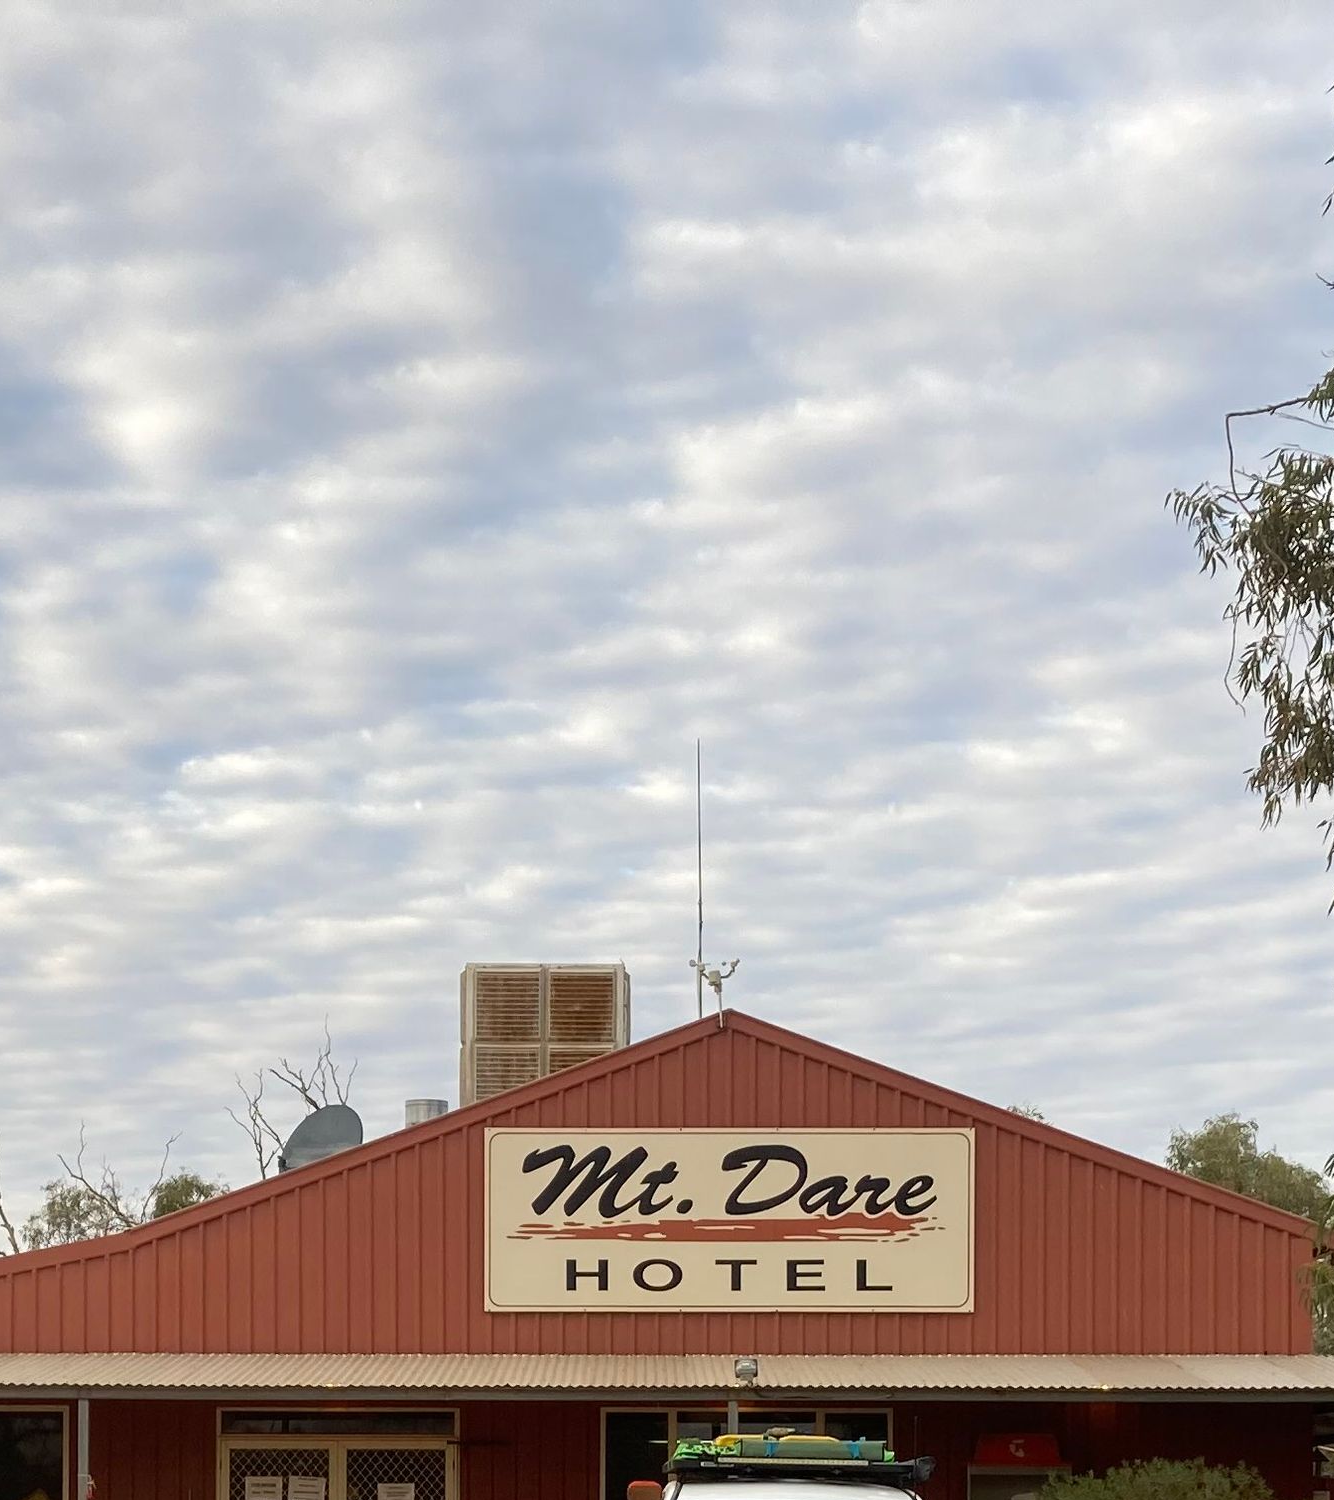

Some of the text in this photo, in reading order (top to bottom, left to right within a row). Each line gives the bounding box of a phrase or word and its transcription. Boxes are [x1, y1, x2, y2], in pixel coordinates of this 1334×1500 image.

[522, 1143, 937, 1218] Mt. Dare
[565, 1258, 894, 1292] HOTEL
